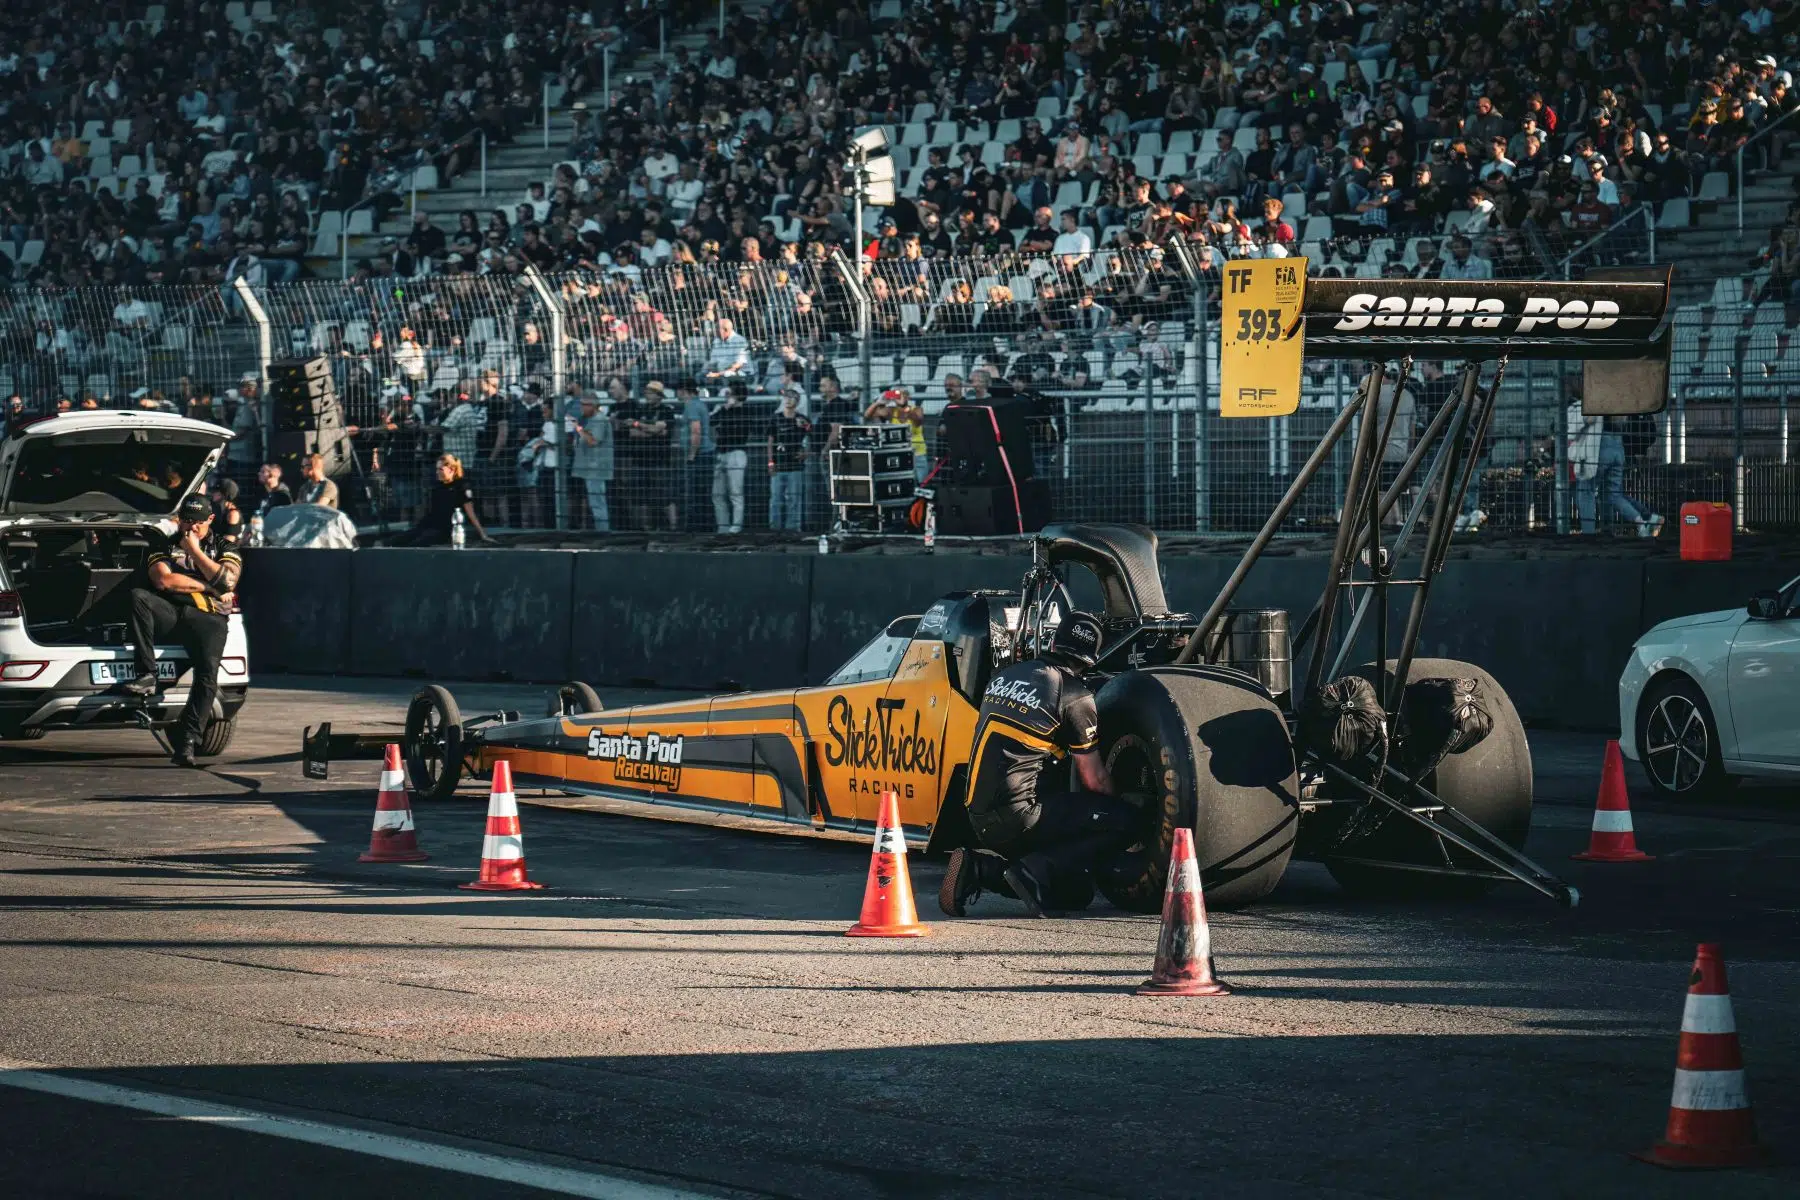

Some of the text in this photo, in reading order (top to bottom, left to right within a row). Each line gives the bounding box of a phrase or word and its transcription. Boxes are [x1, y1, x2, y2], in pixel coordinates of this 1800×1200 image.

[1228, 268, 1252, 293] TF
[1236, 308, 1282, 342] 393
[1238, 387, 1278, 401] RF
[983, 696, 1029, 714] RACING
[587, 729, 684, 764] Santa Pod
[615, 755, 680, 790] Raceway
[848, 778, 914, 799] RACING
